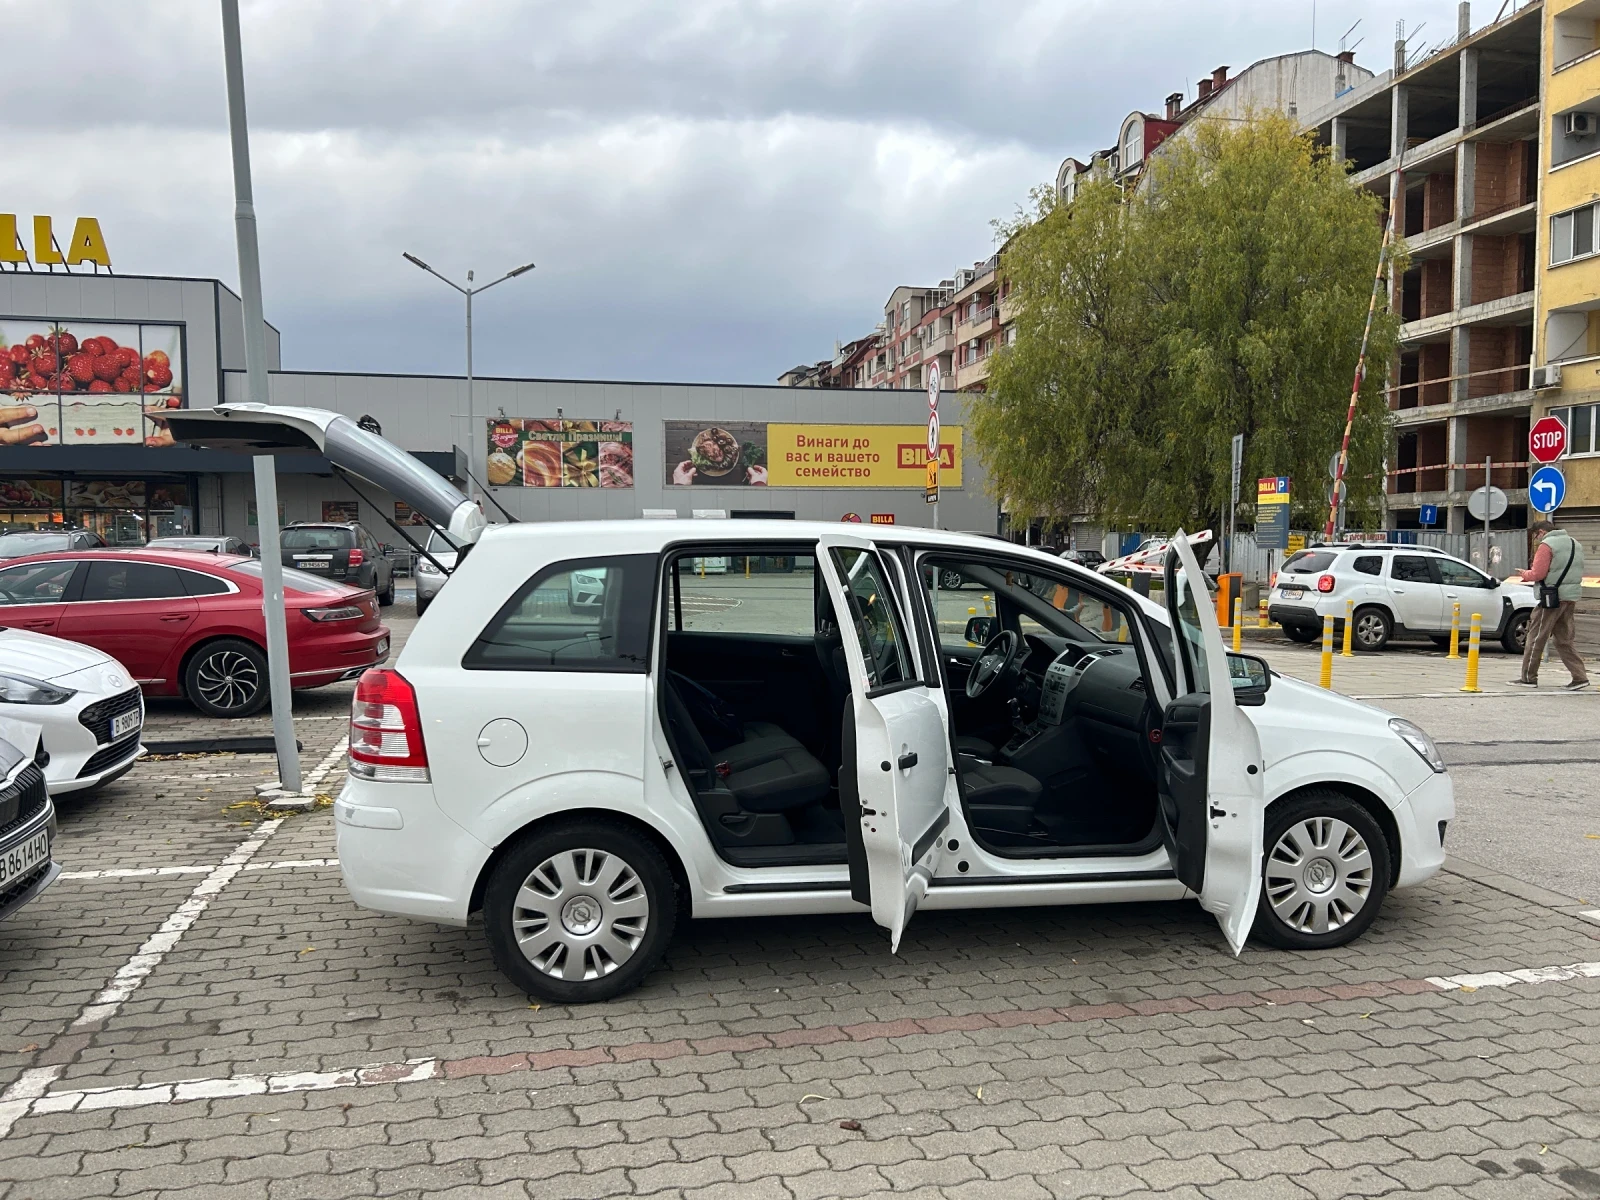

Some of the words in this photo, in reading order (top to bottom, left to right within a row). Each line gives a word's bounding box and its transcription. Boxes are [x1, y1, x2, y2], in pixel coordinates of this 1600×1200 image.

[528, 430, 566, 442] Светли
[796, 434, 849, 448] Винаги
[852, 439, 870, 450] до
[1533, 431, 1562, 449] STOP
[786, 452, 810, 462] вас
[814, 453, 823, 462] и
[827, 453, 880, 463] вашето
[901, 448, 951, 465] BILA
[795, 464, 871, 477] семейство
[1258, 482, 1276, 491] BILLA
[1278, 480, 1285, 491] P
[872, 515, 894, 524] BILLA
[115, 719, 120, 734] B
